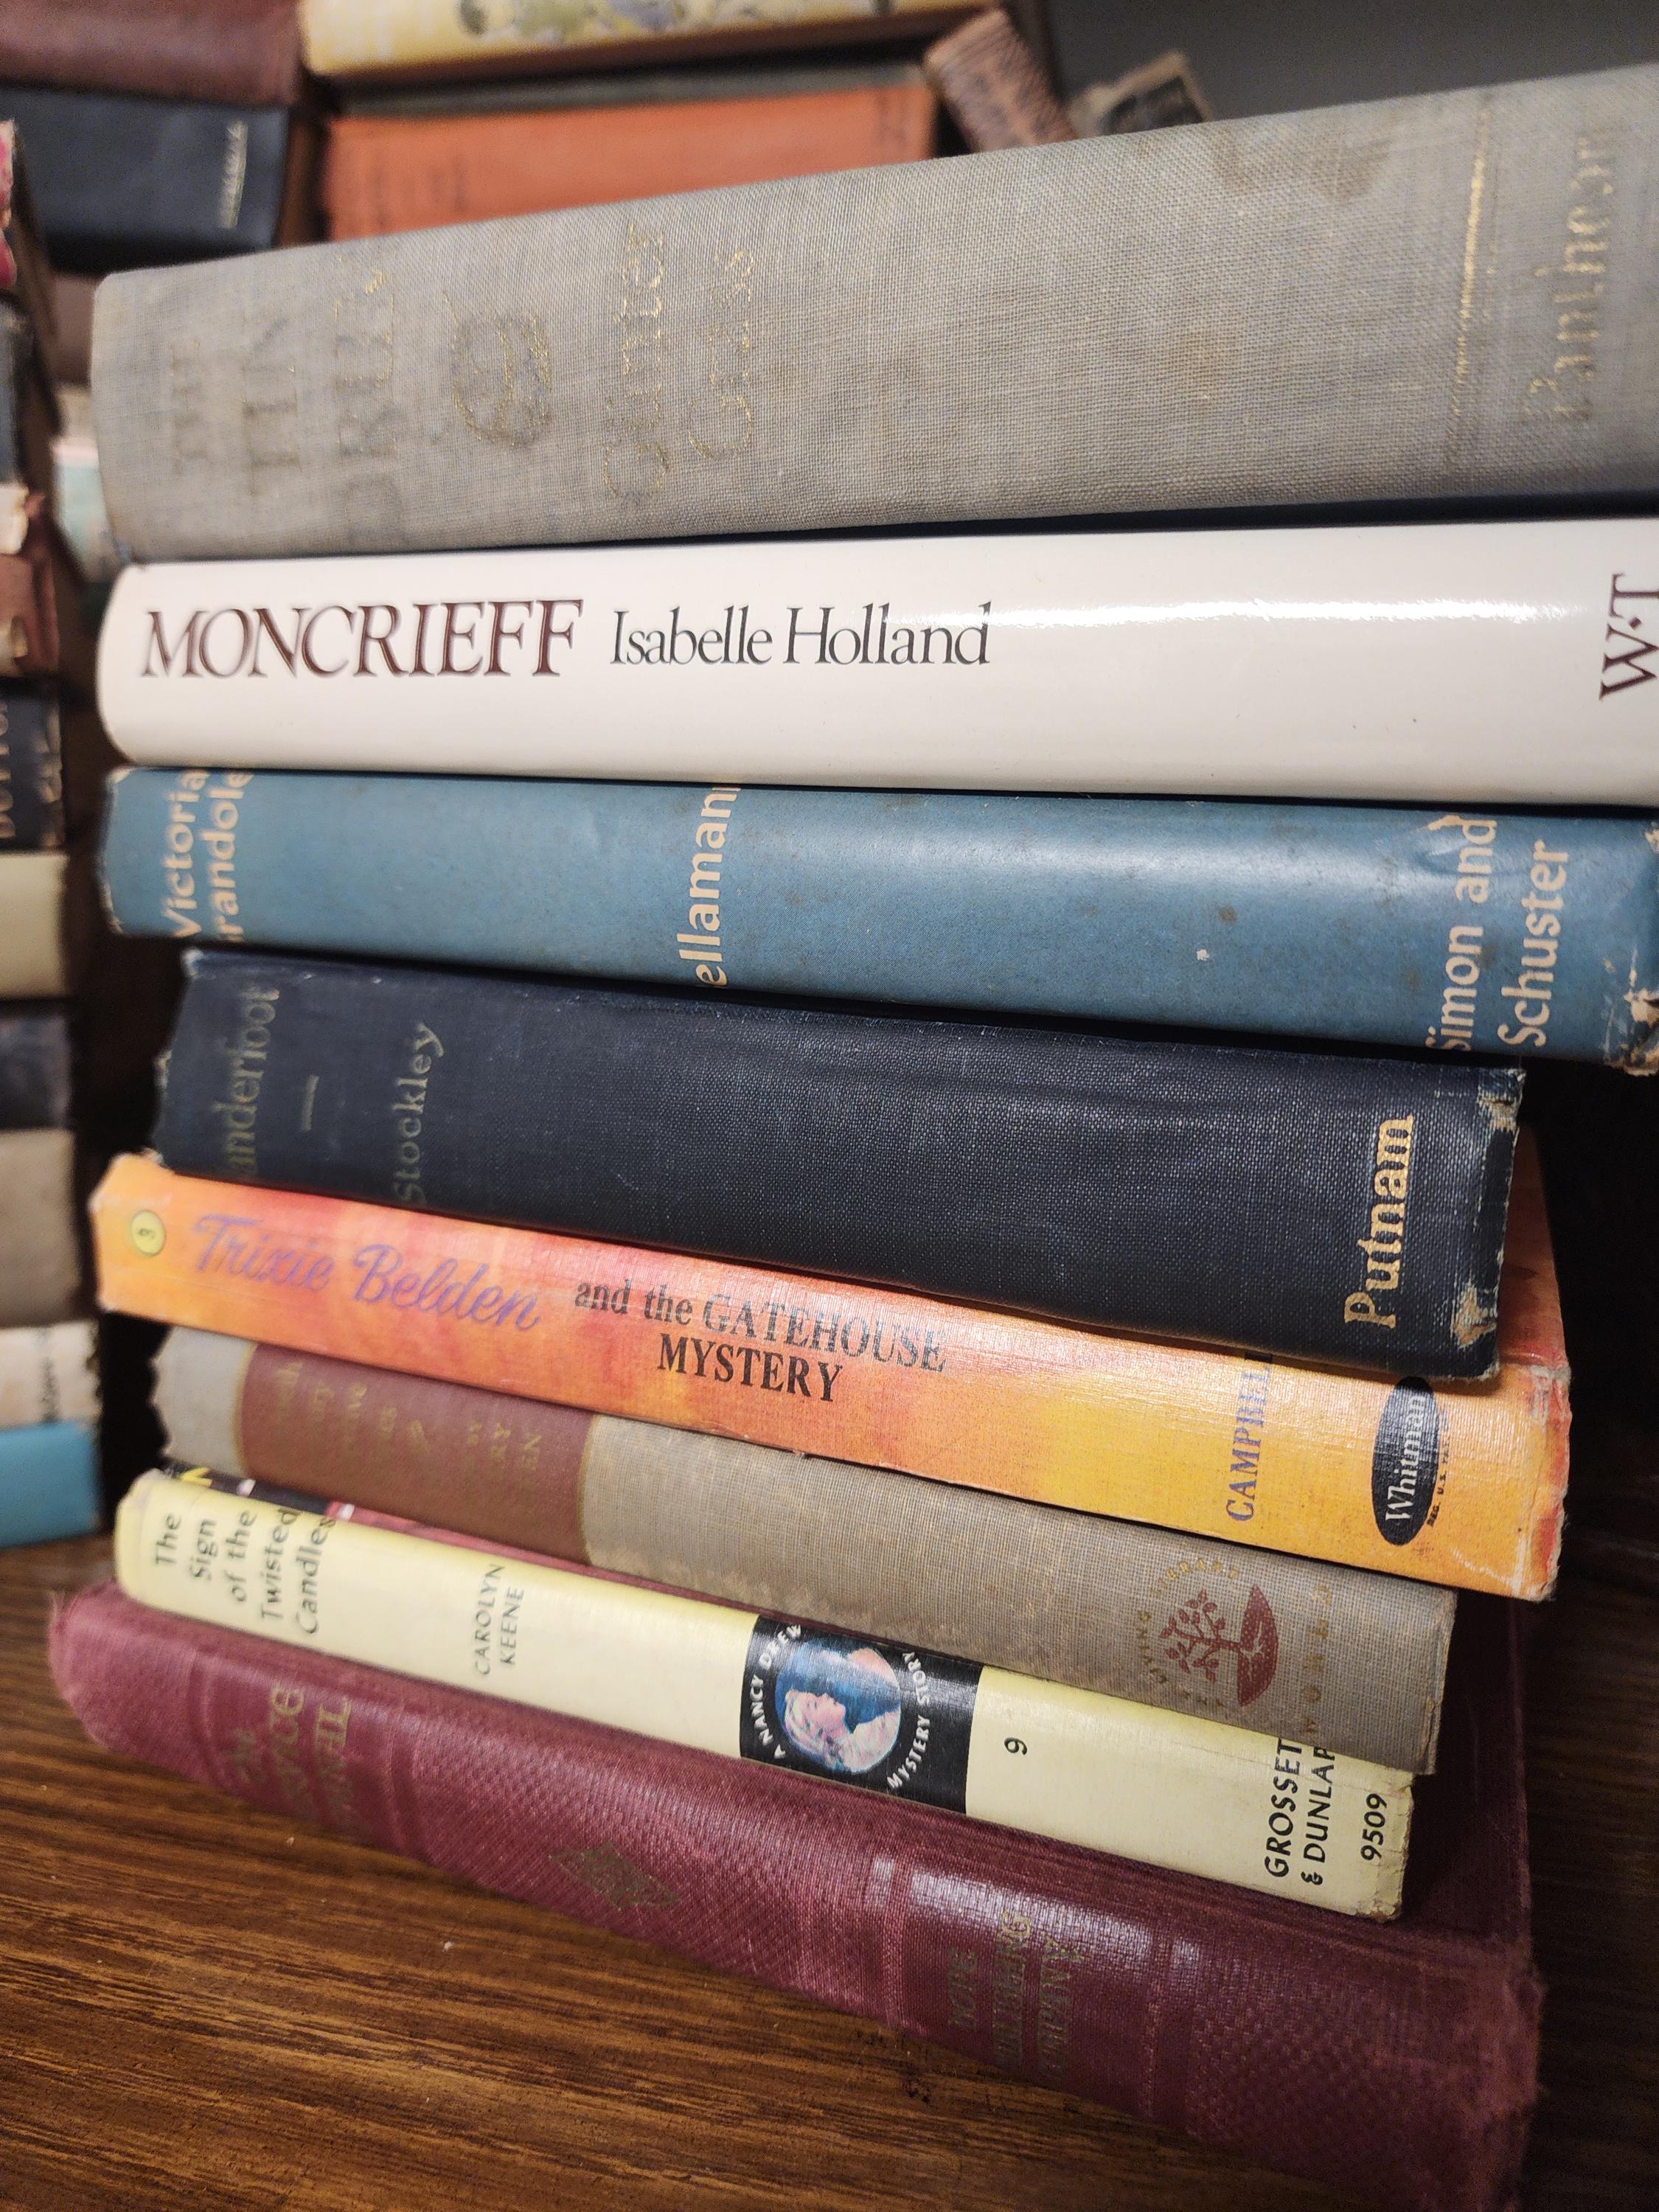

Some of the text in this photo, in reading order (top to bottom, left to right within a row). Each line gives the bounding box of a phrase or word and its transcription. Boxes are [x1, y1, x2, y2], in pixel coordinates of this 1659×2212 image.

[141, 599, 583, 678] MONCRIEFF
[611, 601, 991, 666] Isabelle Holland
[676, 787, 741, 987] ellaman
[1427, 815, 1498, 903] and
[1497, 839, 1569, 1048] Schuster
[212, 984, 281, 1176] anderfoot
[391, 1022, 445, 1206] Stockley
[193, 1213, 542, 1331] Trixie Belden
[1344, 1114, 1414, 1329] Putnam
[574, 1278, 947, 1373] and the GATEHOUSE
[657, 1332, 844, 1403] MYSTERY
[1385, 1394, 1427, 1523] Whitman
[156, 1512, 182, 1568] The
[189, 1518, 218, 1582] Sign
[225, 1509, 258, 1604] of the
[261, 1507, 302, 1623] Twisted
[296, 1517, 337, 1635] Candles
[474, 1563, 507, 1676] CAROLYN
[499, 1587, 525, 1666] KEENE
[750, 1624, 802, 1760] A NANCY DREW
[886, 1651, 932, 1790] MYSTERY STORY
[1004, 1736, 1028, 1757] 9
[1264, 1737, 1302, 1878] GROSSET
[1301, 1746, 1336, 1886] & DUNLAP
[1360, 1793, 1388, 1862] 9509
